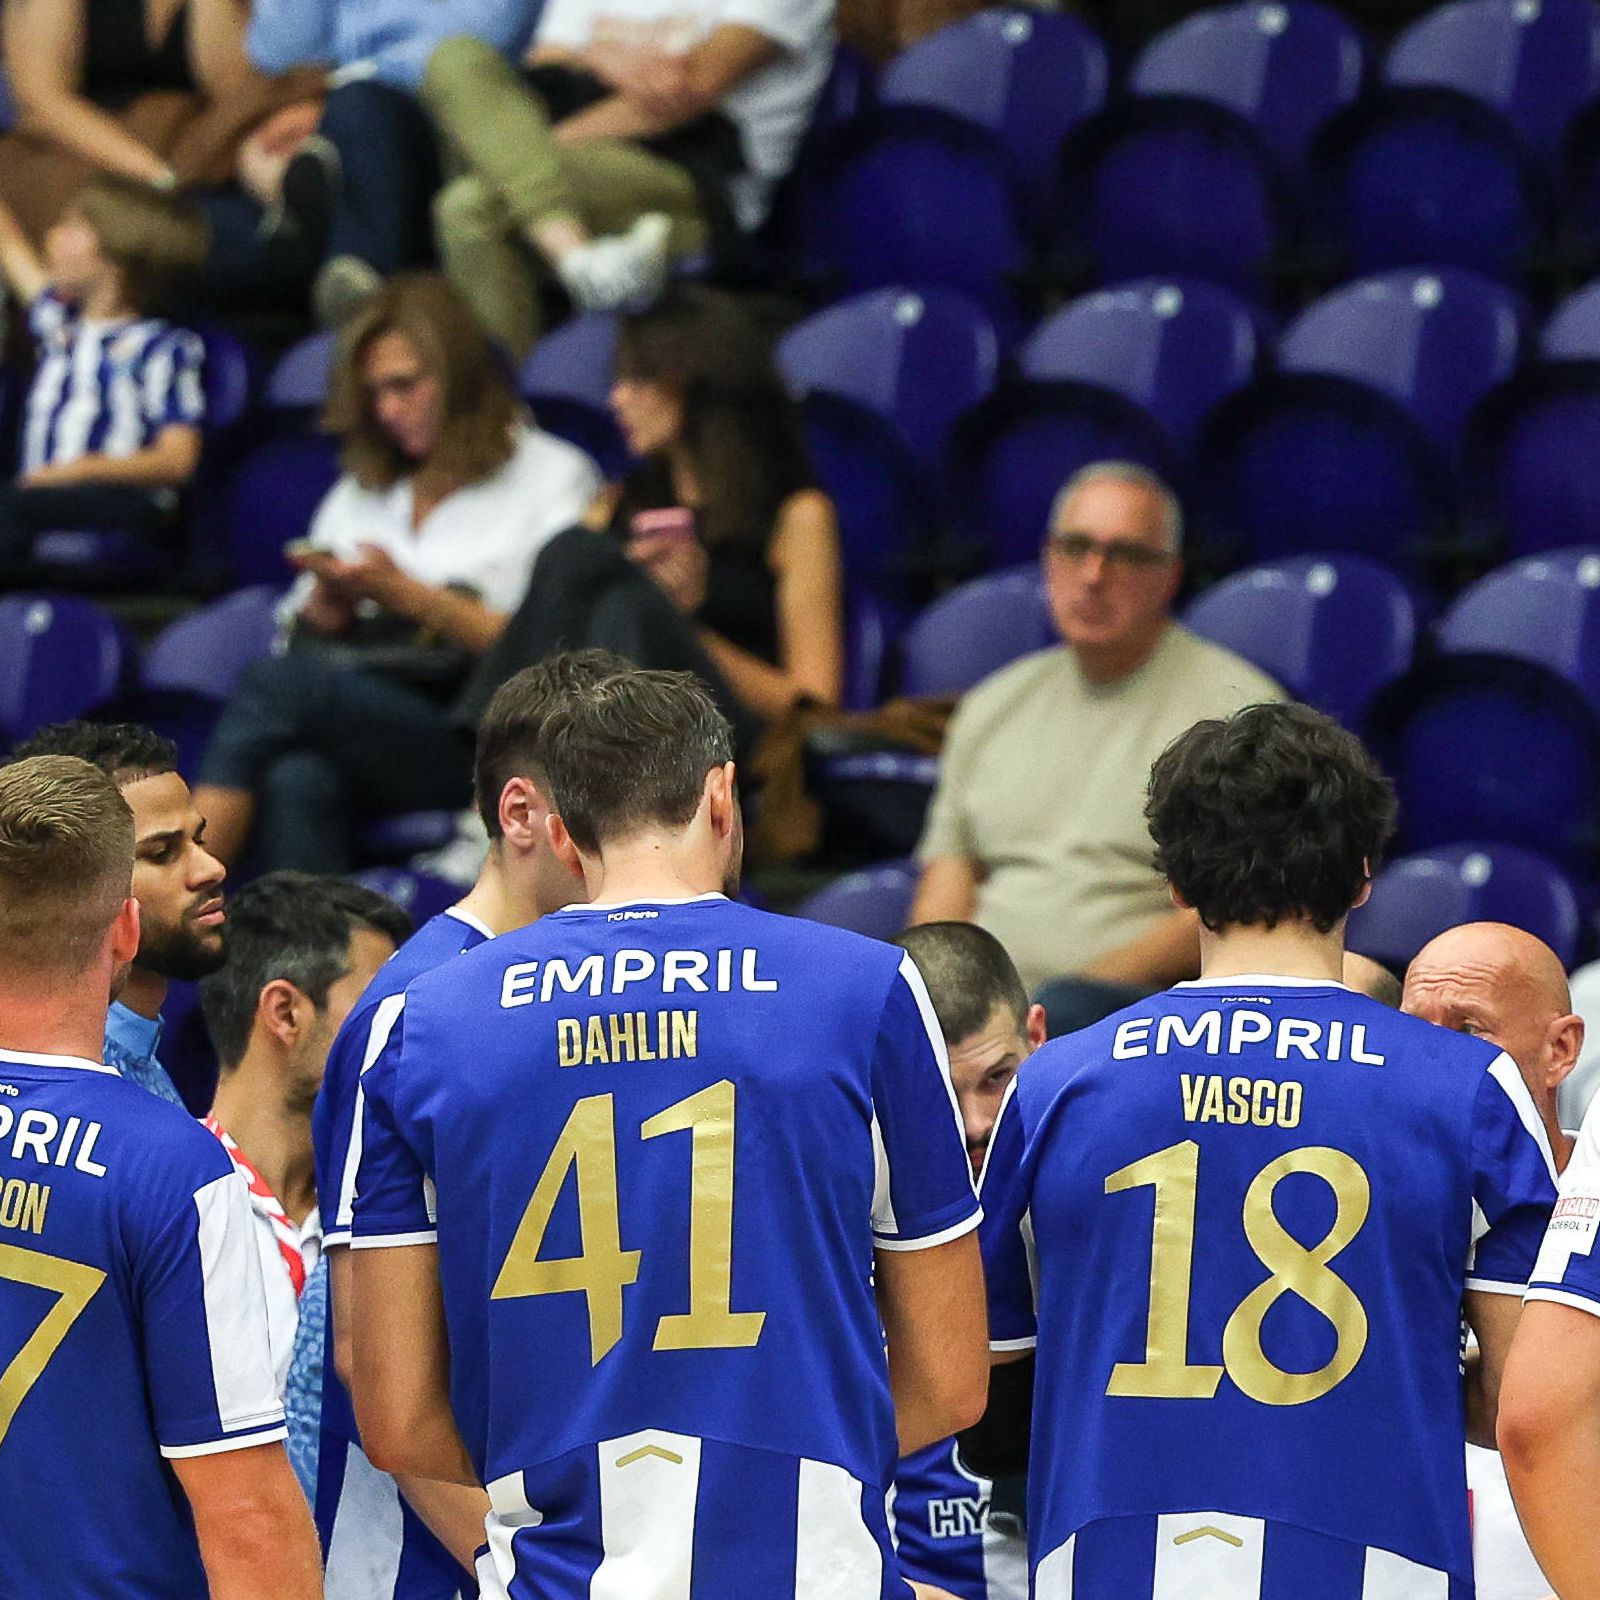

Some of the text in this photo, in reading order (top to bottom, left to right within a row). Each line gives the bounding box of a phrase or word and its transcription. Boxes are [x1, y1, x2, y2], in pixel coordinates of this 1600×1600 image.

[499, 948, 779, 1009] EMPRIL
[556, 1009, 698, 1069] DAHLIN
[1112, 1009, 1386, 1066] EMPRIL
[1180, 1073, 1303, 1129] VASCO
[489, 1078, 767, 1368] 41
[1104, 1139, 1371, 1406] 18
